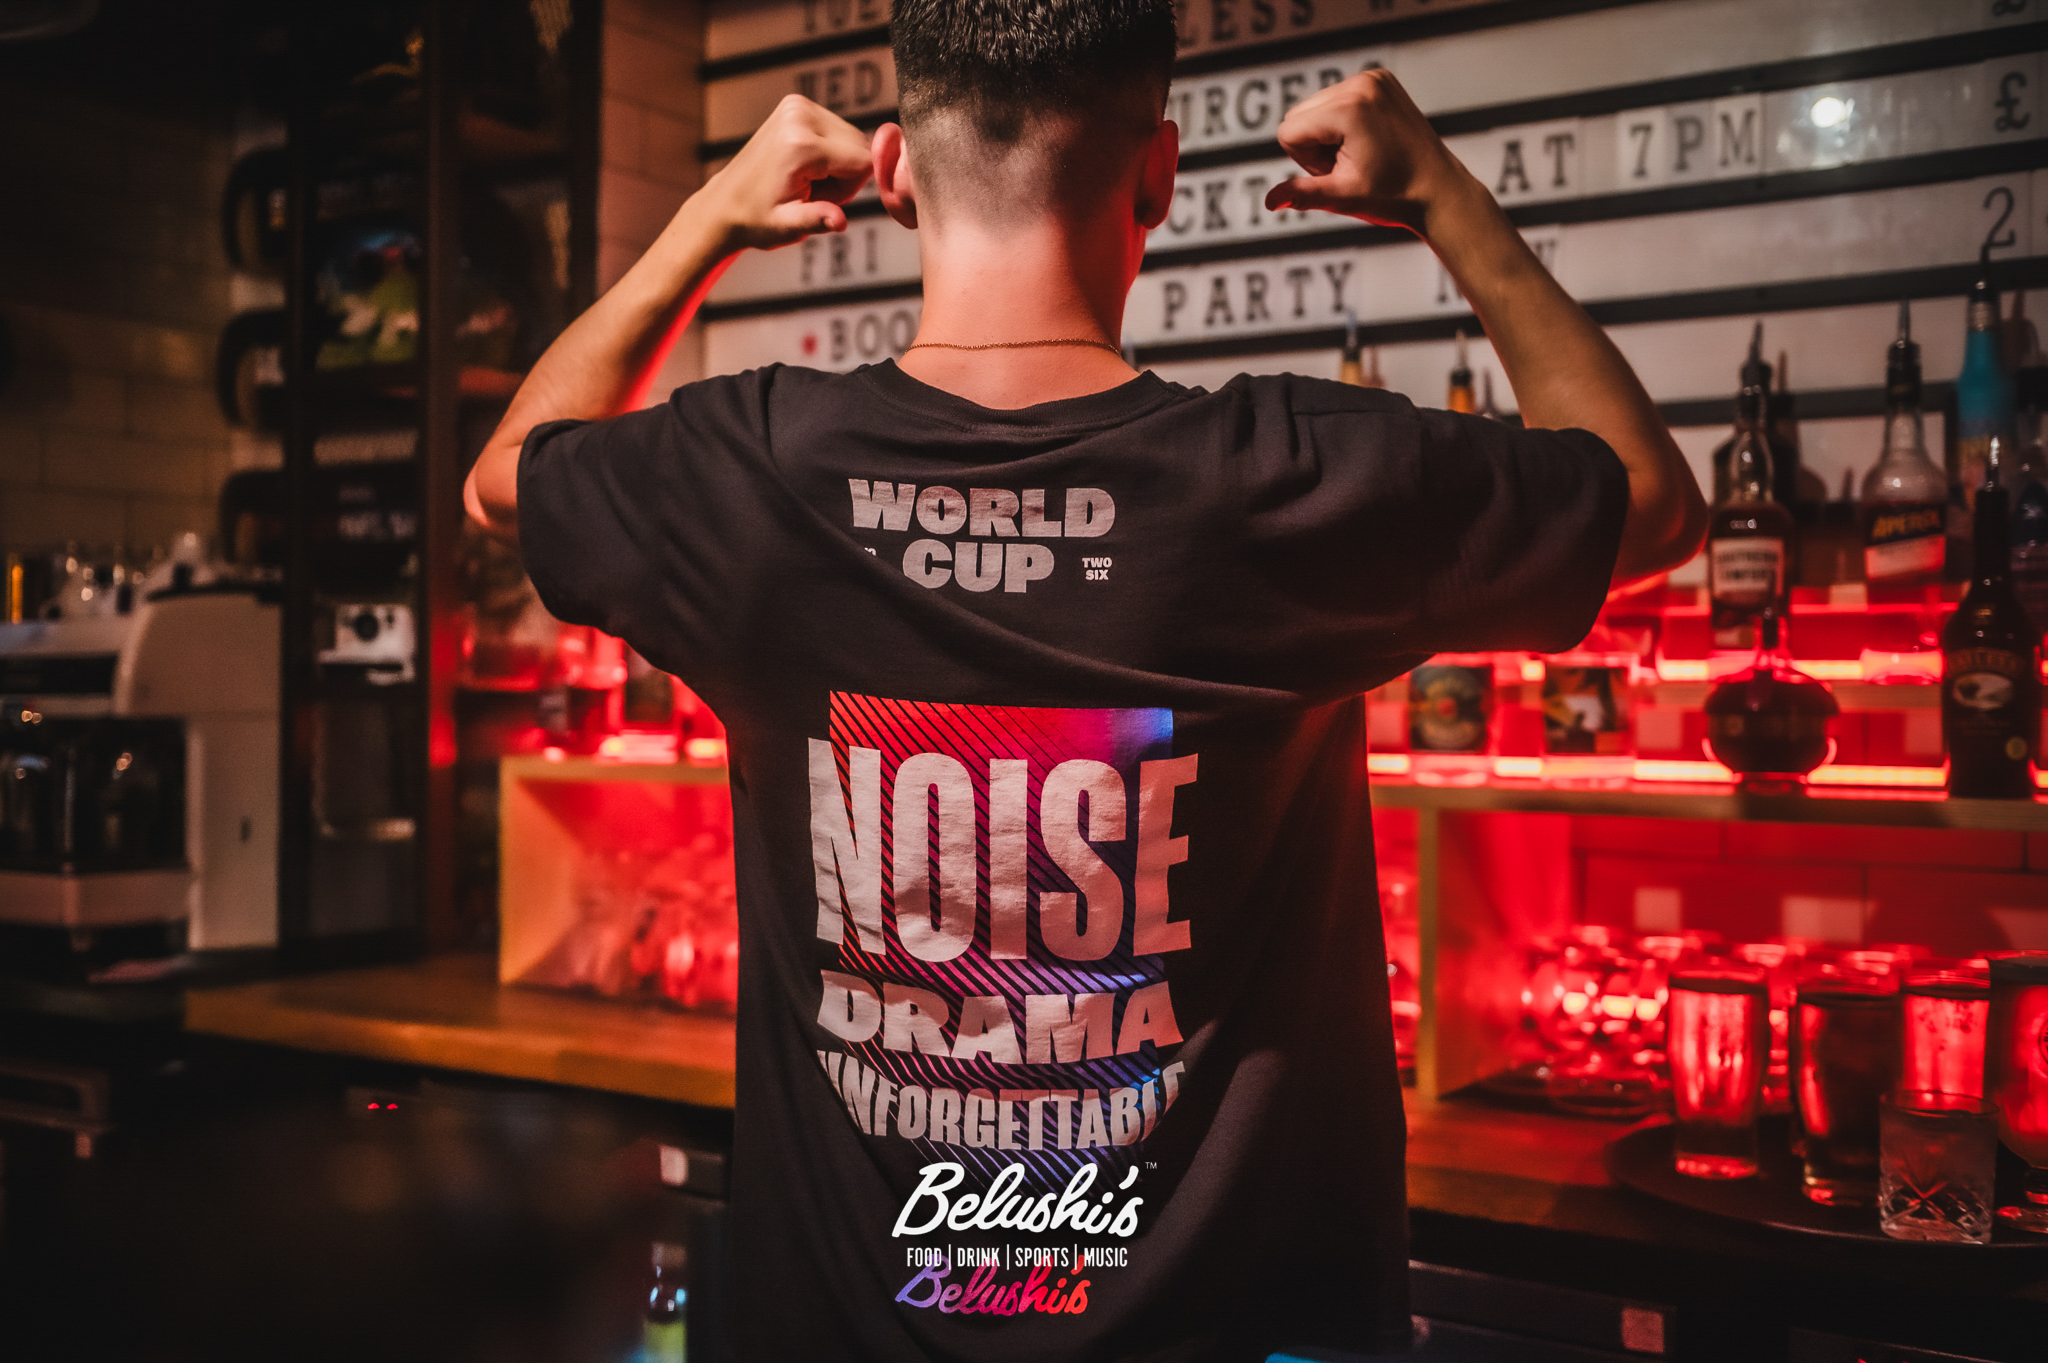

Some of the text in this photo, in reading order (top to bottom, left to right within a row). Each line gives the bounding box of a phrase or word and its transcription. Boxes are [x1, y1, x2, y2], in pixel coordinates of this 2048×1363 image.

[795, 61, 882, 109] WED
[1167, 60, 1382, 141] URGE
[1495, 108, 1757, 194] AT 7PM
[801, 226, 878, 284] FRI
[1161, 260, 1354, 332] PARTY
[848, 478, 1116, 538] WORLD
[902, 538, 1055, 593] CUP
[1082, 557, 1112, 569] TWO
[1085, 569, 1109, 581] SIX
[808, 737, 1199, 963] NOISE
[816, 969, 1184, 1065] DRAMA
[894, 1254, 1091, 1317] Belushi's
